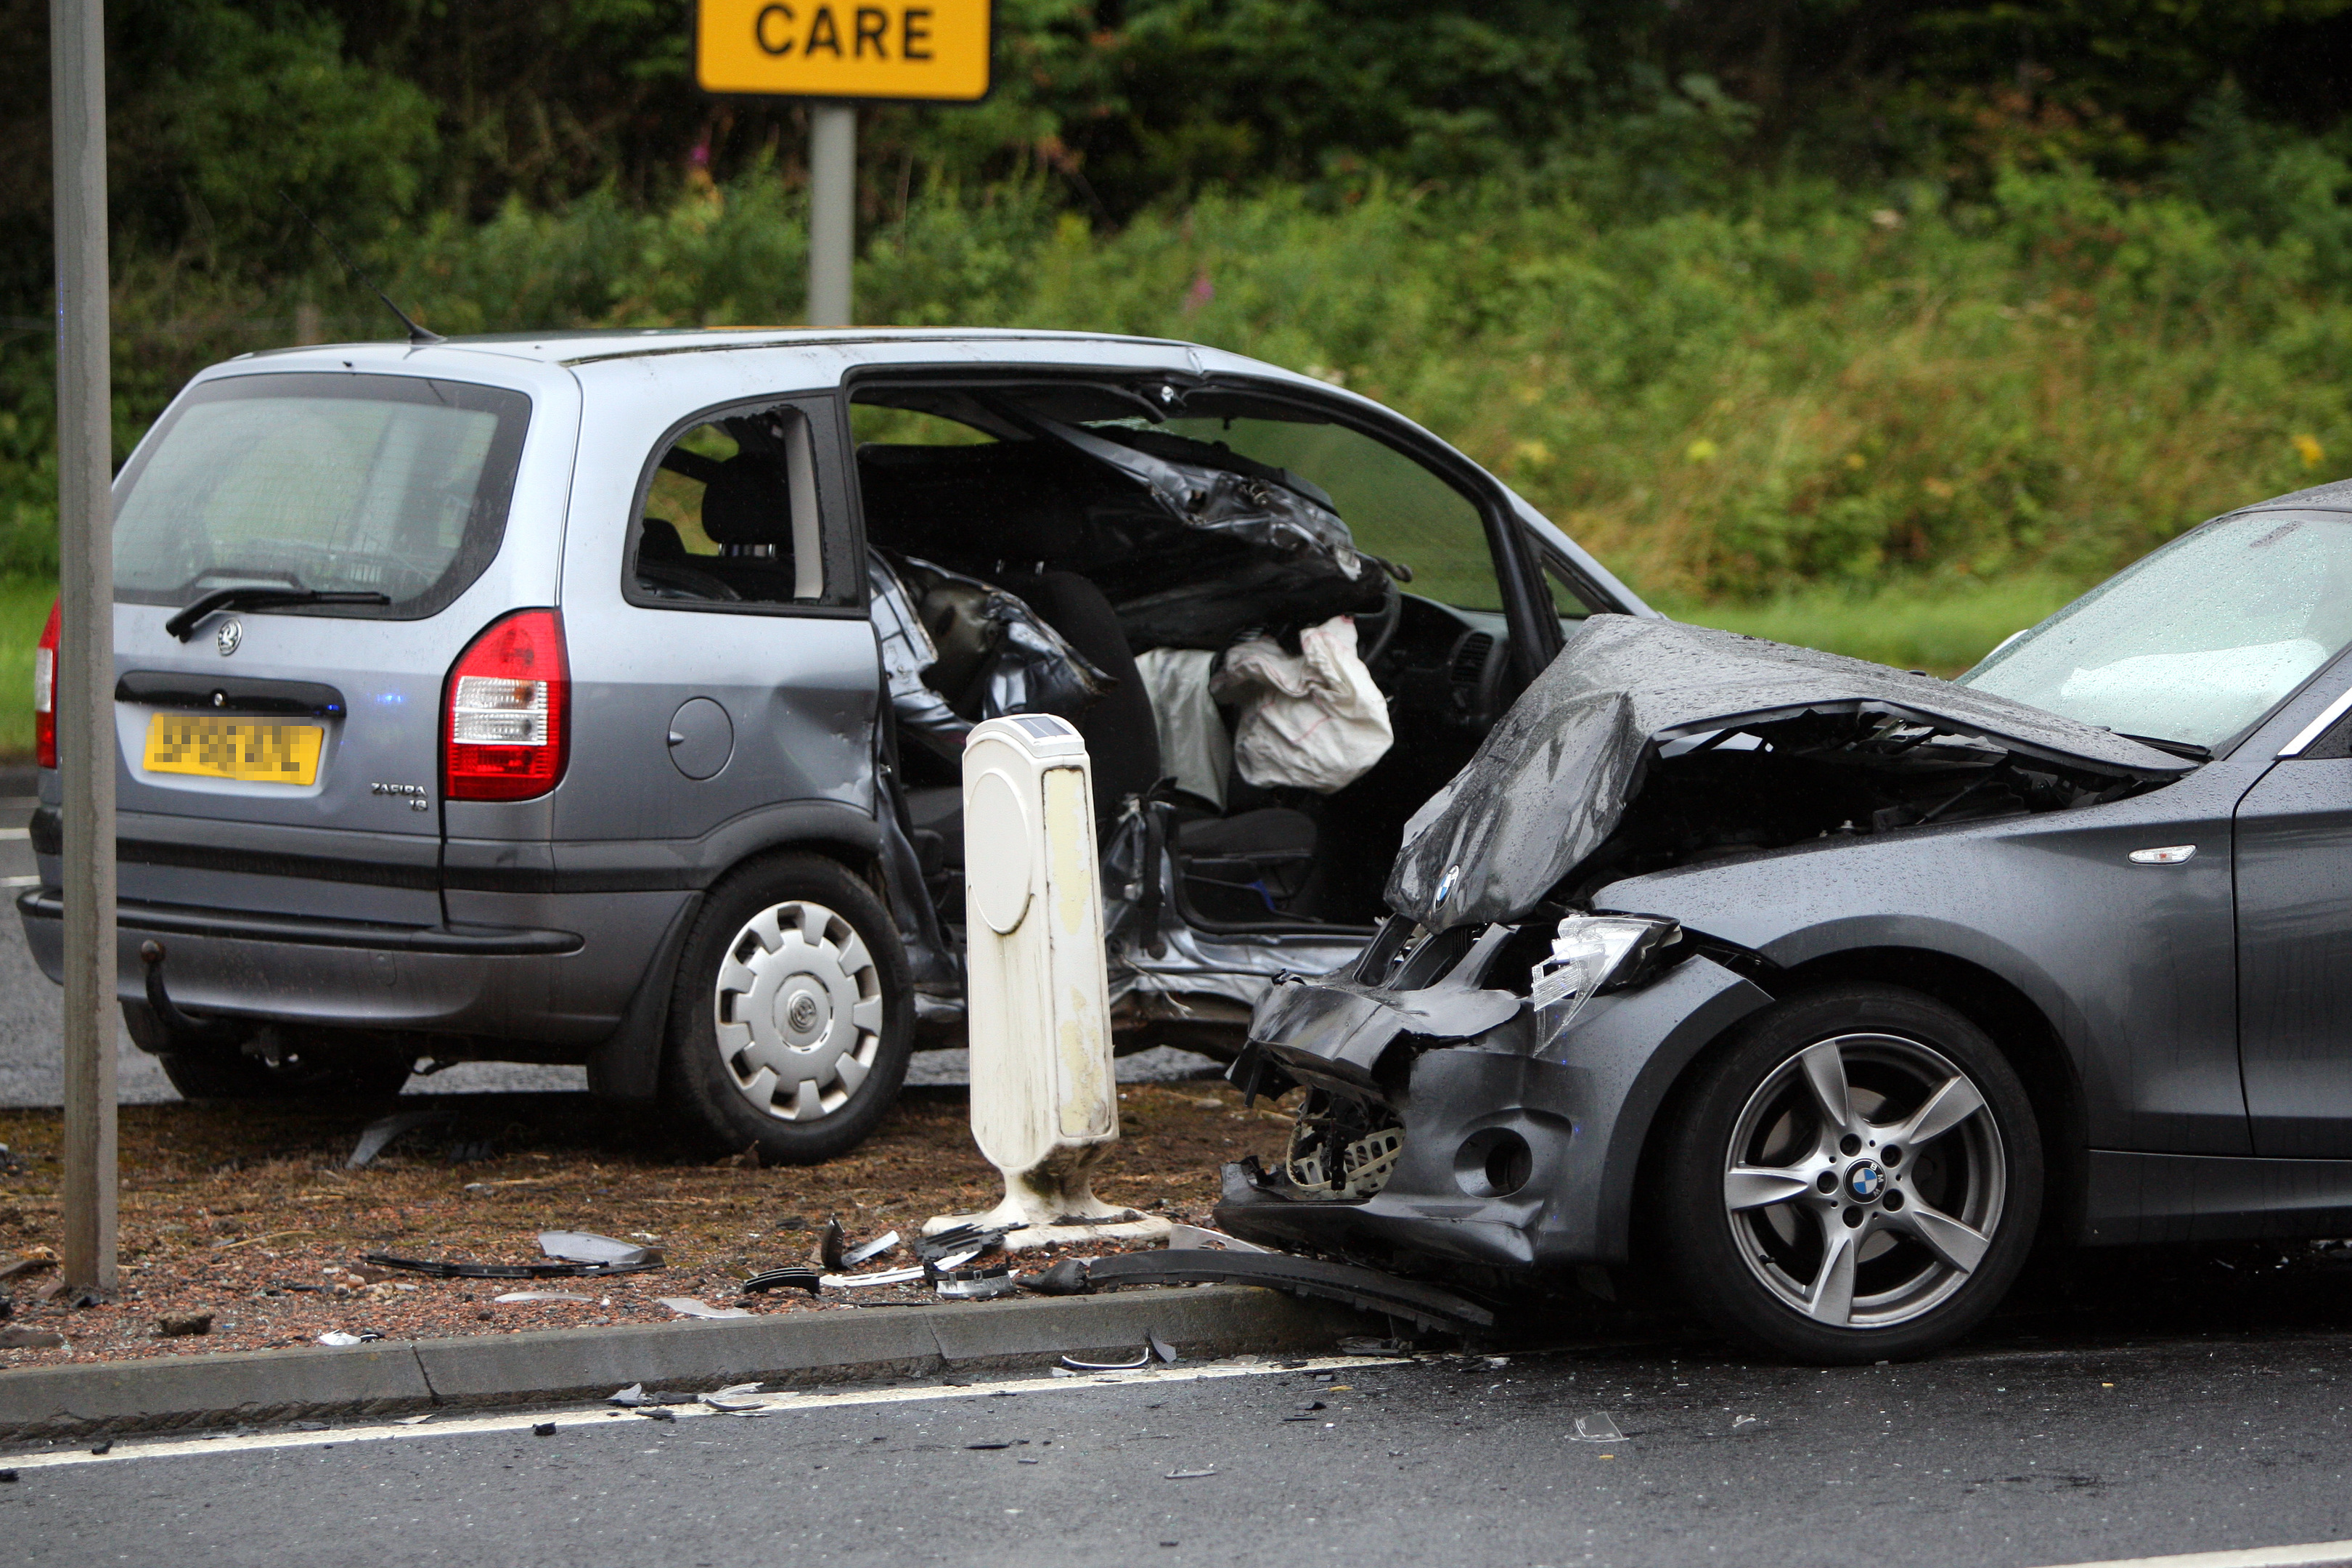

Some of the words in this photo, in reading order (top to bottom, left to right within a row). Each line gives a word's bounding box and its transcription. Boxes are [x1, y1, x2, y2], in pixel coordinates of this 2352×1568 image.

[756, 4, 933, 60] CARE
[371, 783, 427, 797] ZAFIRA
[1870, 1163, 1884, 1197] BMW
